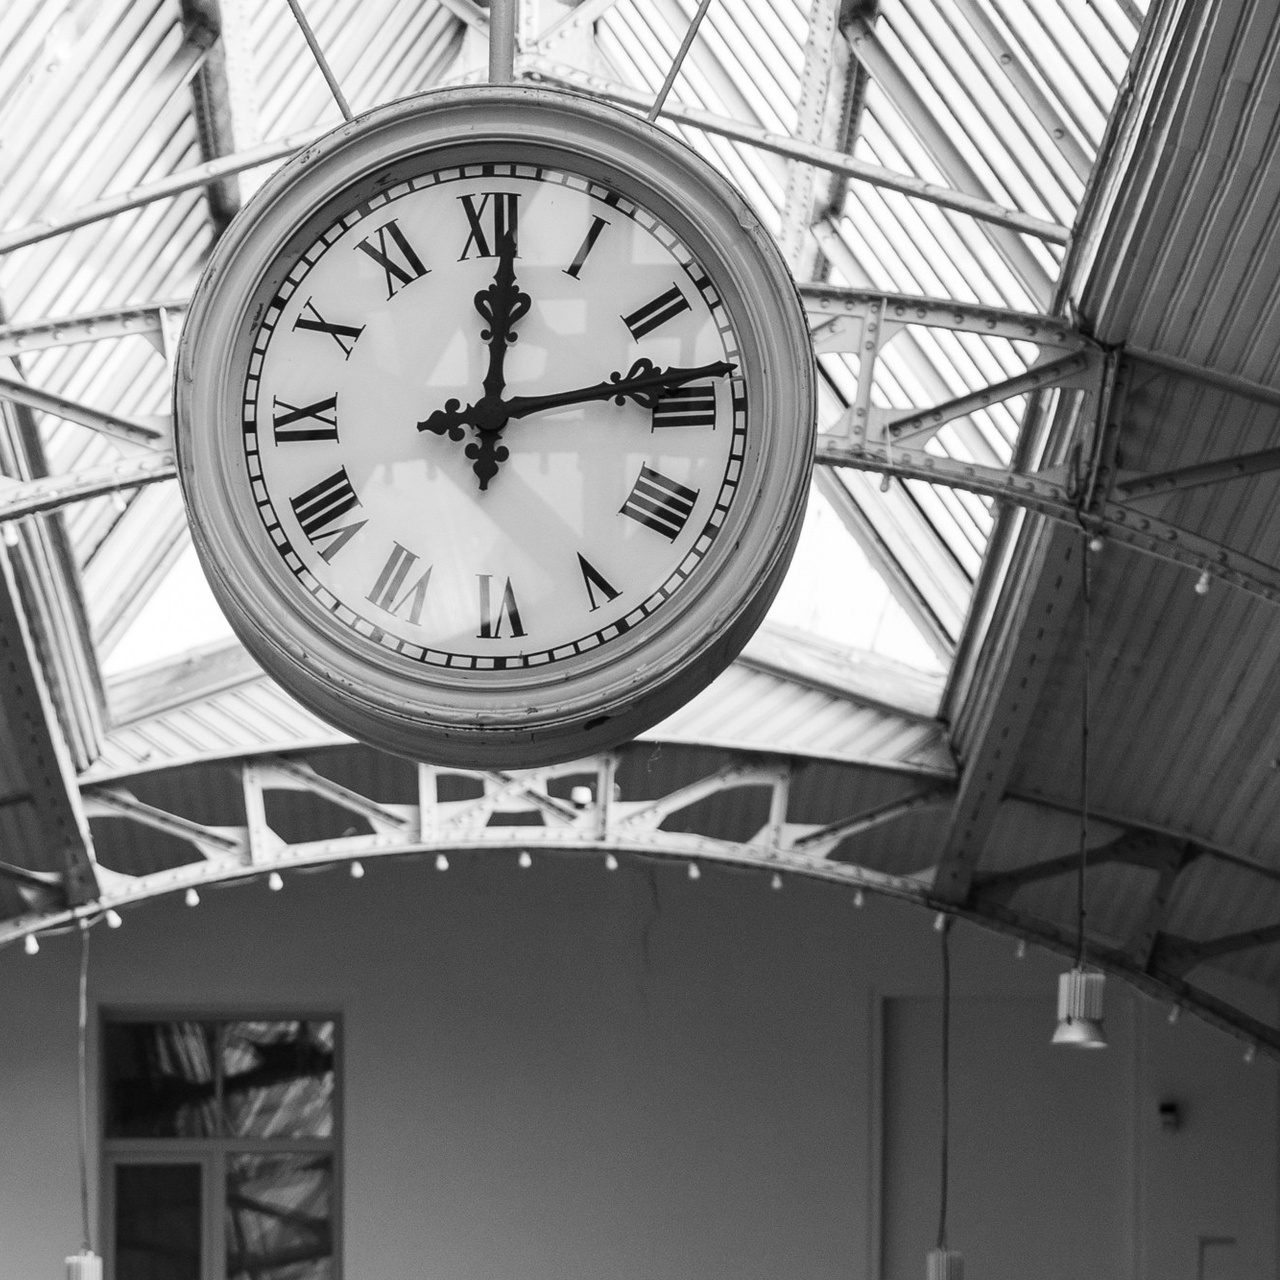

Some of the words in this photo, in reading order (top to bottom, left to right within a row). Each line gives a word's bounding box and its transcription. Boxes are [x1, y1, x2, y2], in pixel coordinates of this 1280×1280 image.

[354, 218, 432, 301] XI
[456, 192, 522, 262] XII
[562, 214, 611, 280] I
[292, 296, 366, 360] X
[620, 282, 692, 344] II
[273, 392, 339, 447] IX
[651, 381, 716, 433] III
[289, 465, 369, 565] VIII
[618, 461, 700, 543] IIII
[365, 541, 434, 626] VII
[475, 574, 527, 639] VI
[576, 551, 623, 612] V
